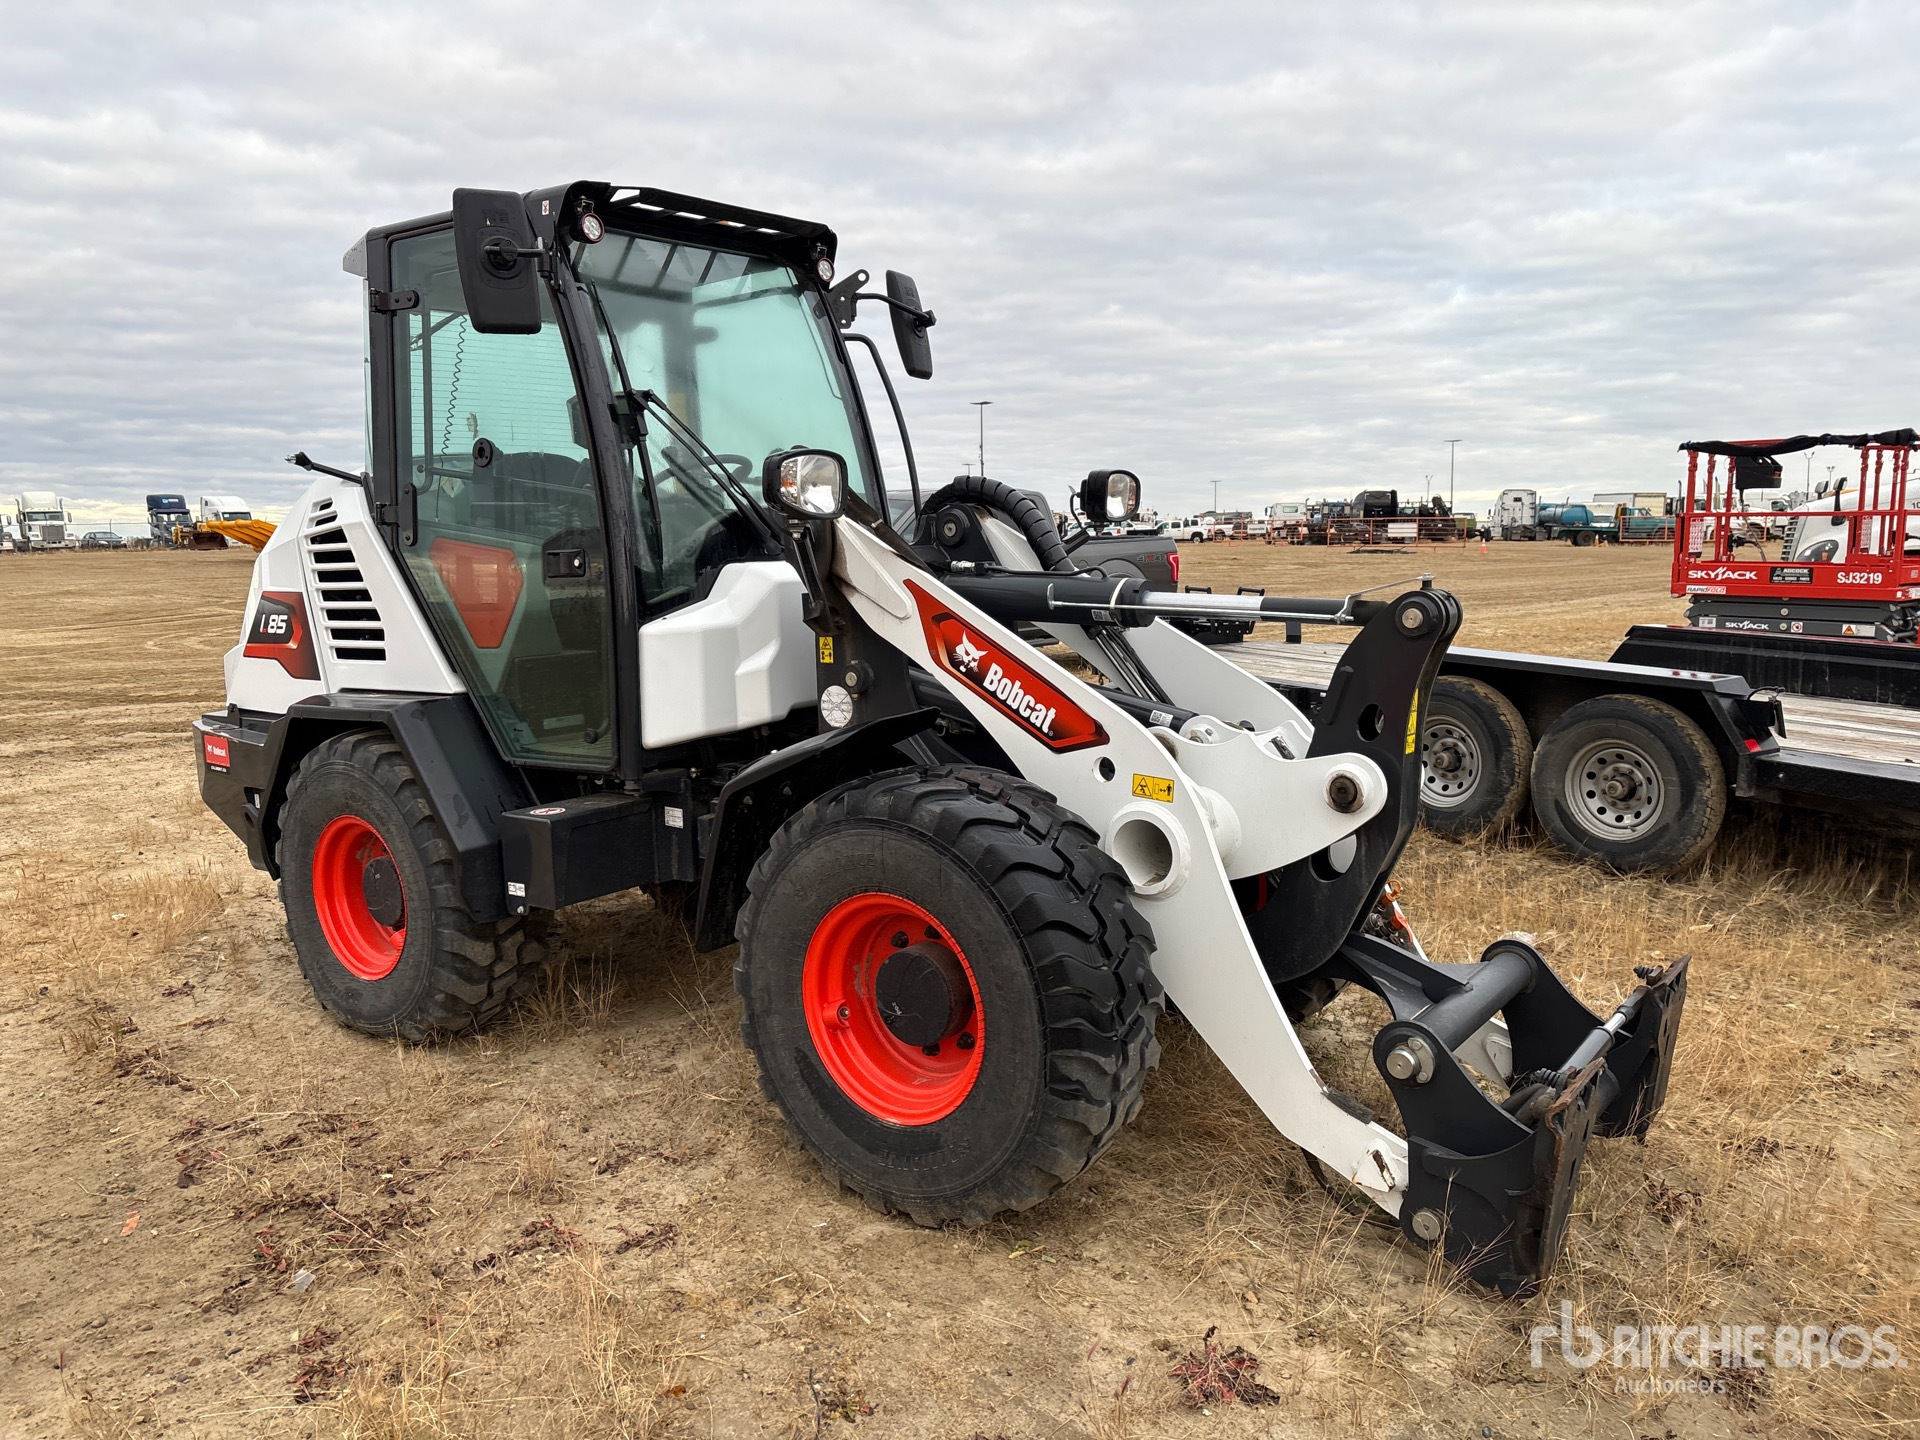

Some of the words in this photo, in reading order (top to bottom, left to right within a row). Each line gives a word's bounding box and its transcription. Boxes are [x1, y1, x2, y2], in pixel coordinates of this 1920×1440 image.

[1688, 566, 1758, 581] SKYJACK
[1837, 572, 1883, 584] SJ3219
[1725, 620, 1769, 630] SKYJACK
[983, 662, 1057, 734] Bobcat
